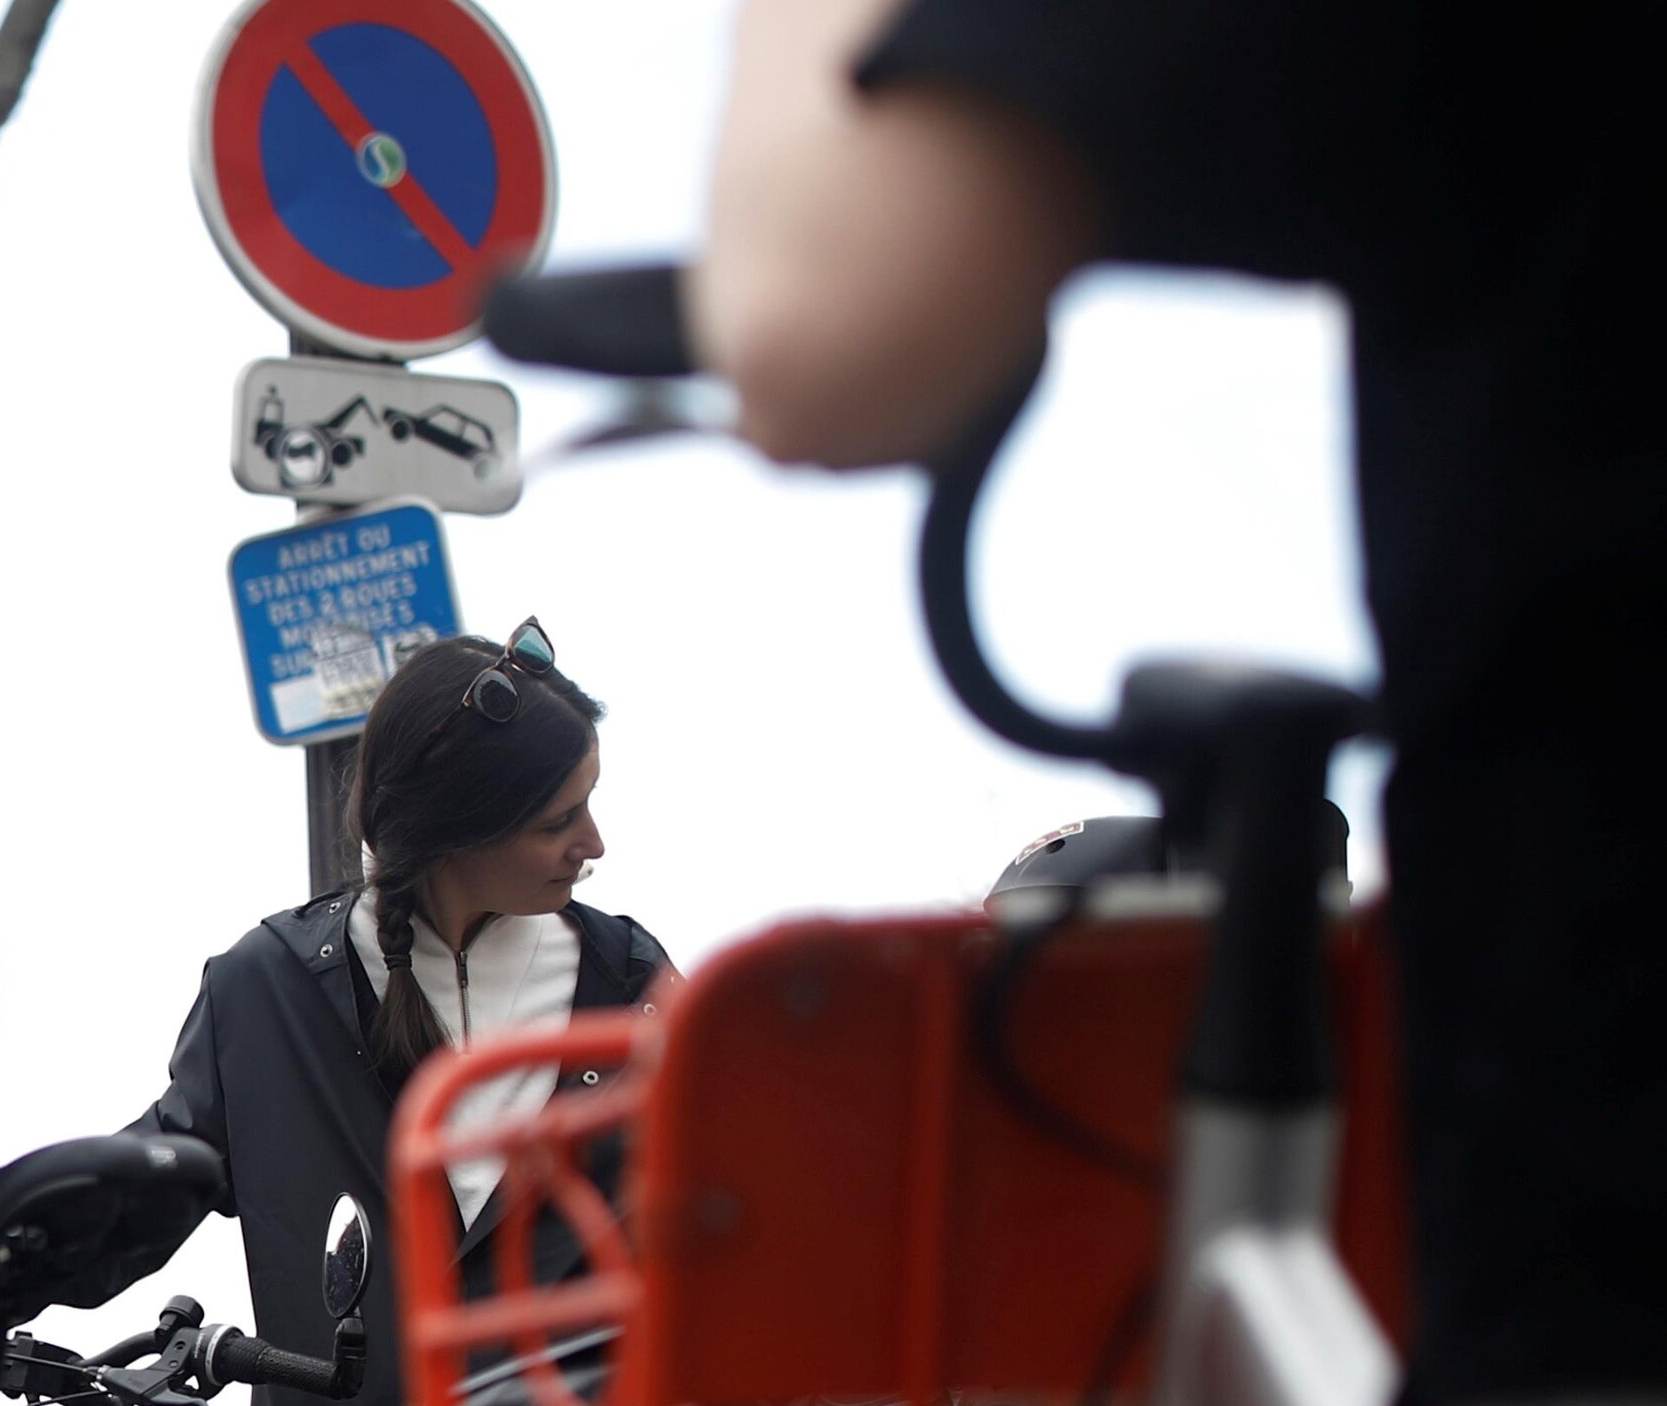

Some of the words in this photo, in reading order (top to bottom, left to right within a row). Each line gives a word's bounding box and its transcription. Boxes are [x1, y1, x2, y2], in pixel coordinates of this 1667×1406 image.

[357, 523, 391, 551] OU
[243, 540, 430, 605] STATIONNEMENT
[269, 595, 314, 626] DES
[340, 571, 417, 609] ROUES
